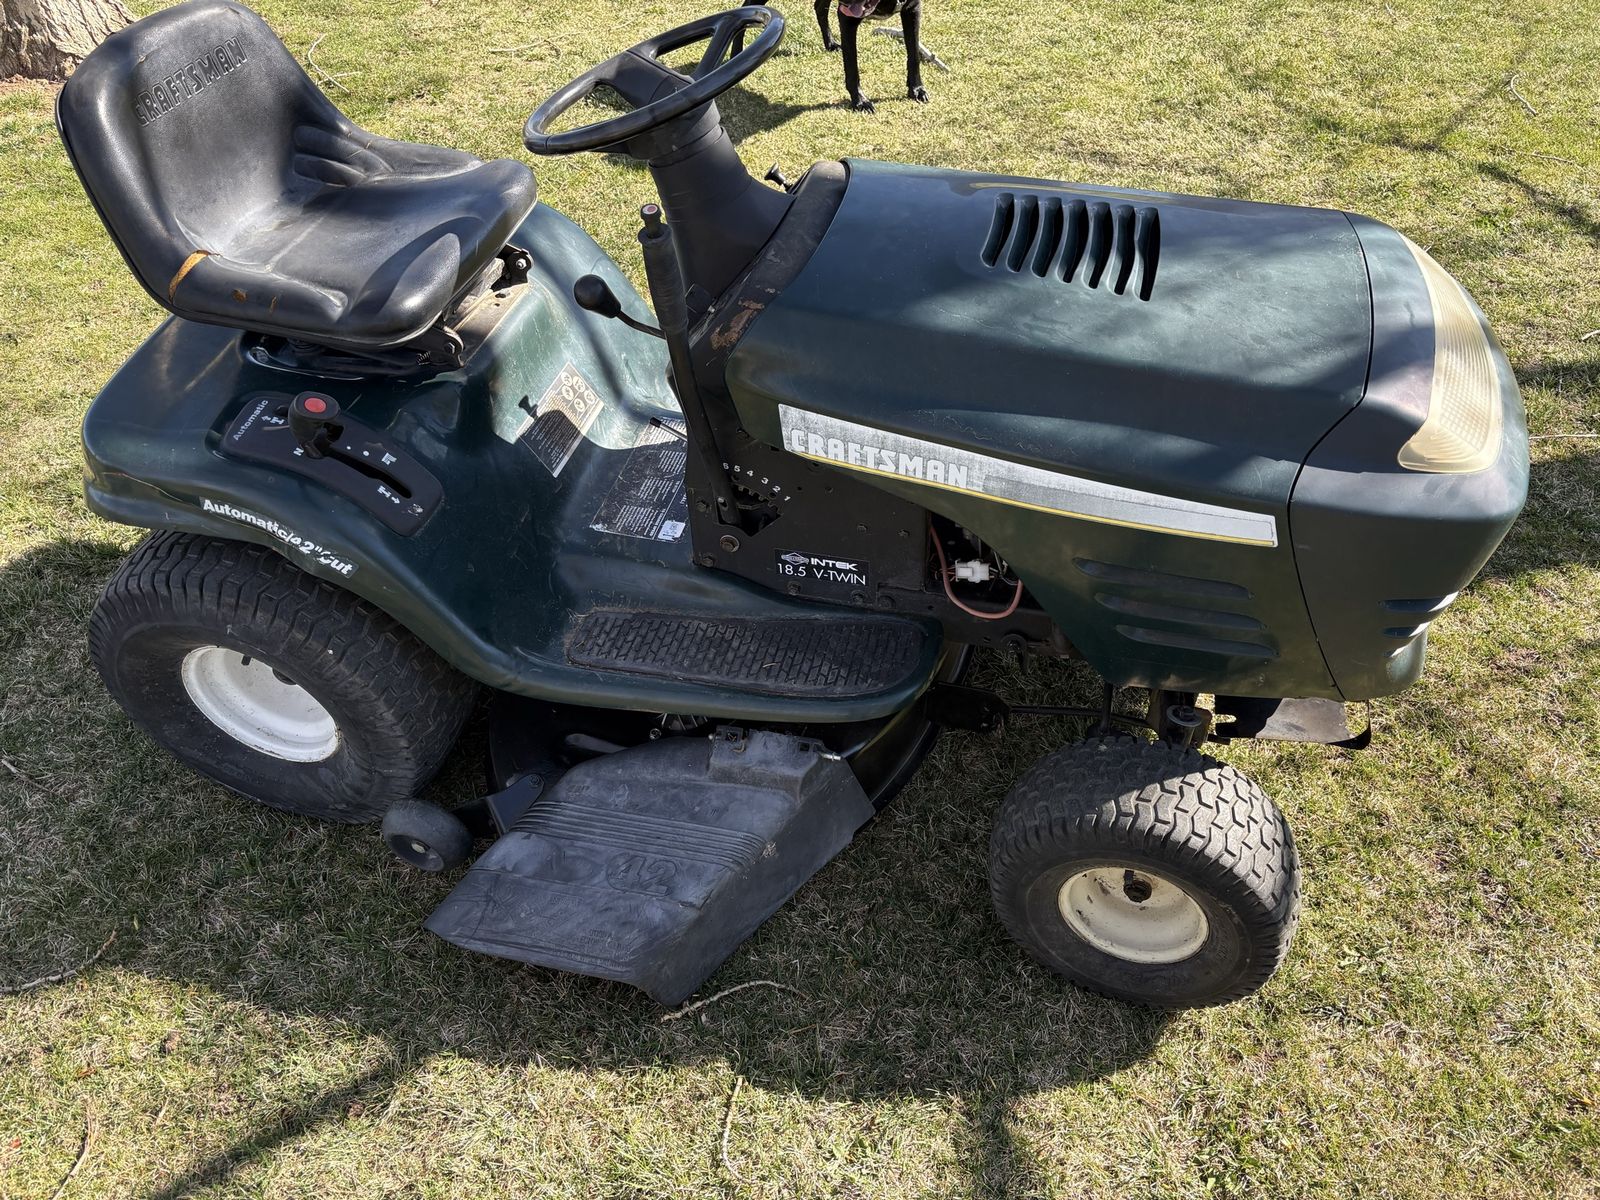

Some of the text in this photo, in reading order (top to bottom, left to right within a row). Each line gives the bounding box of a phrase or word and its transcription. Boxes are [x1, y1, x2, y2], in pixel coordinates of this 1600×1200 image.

[135, 36, 248, 127] CRAFTSMAN
[233, 400, 268, 440] Automatic
[293, 447, 304, 456] N
[791, 428, 968, 488] CRAFTSMAN
[733, 465, 741, 473] 5
[747, 470, 755, 478] 4
[761, 477, 770, 486] 3
[772, 485, 781, 494] 2
[777, 562, 866, 586] 18.5 V-TWIN
[810, 557, 858, 572] INTEK
[606, 853, 677, 896] 42
